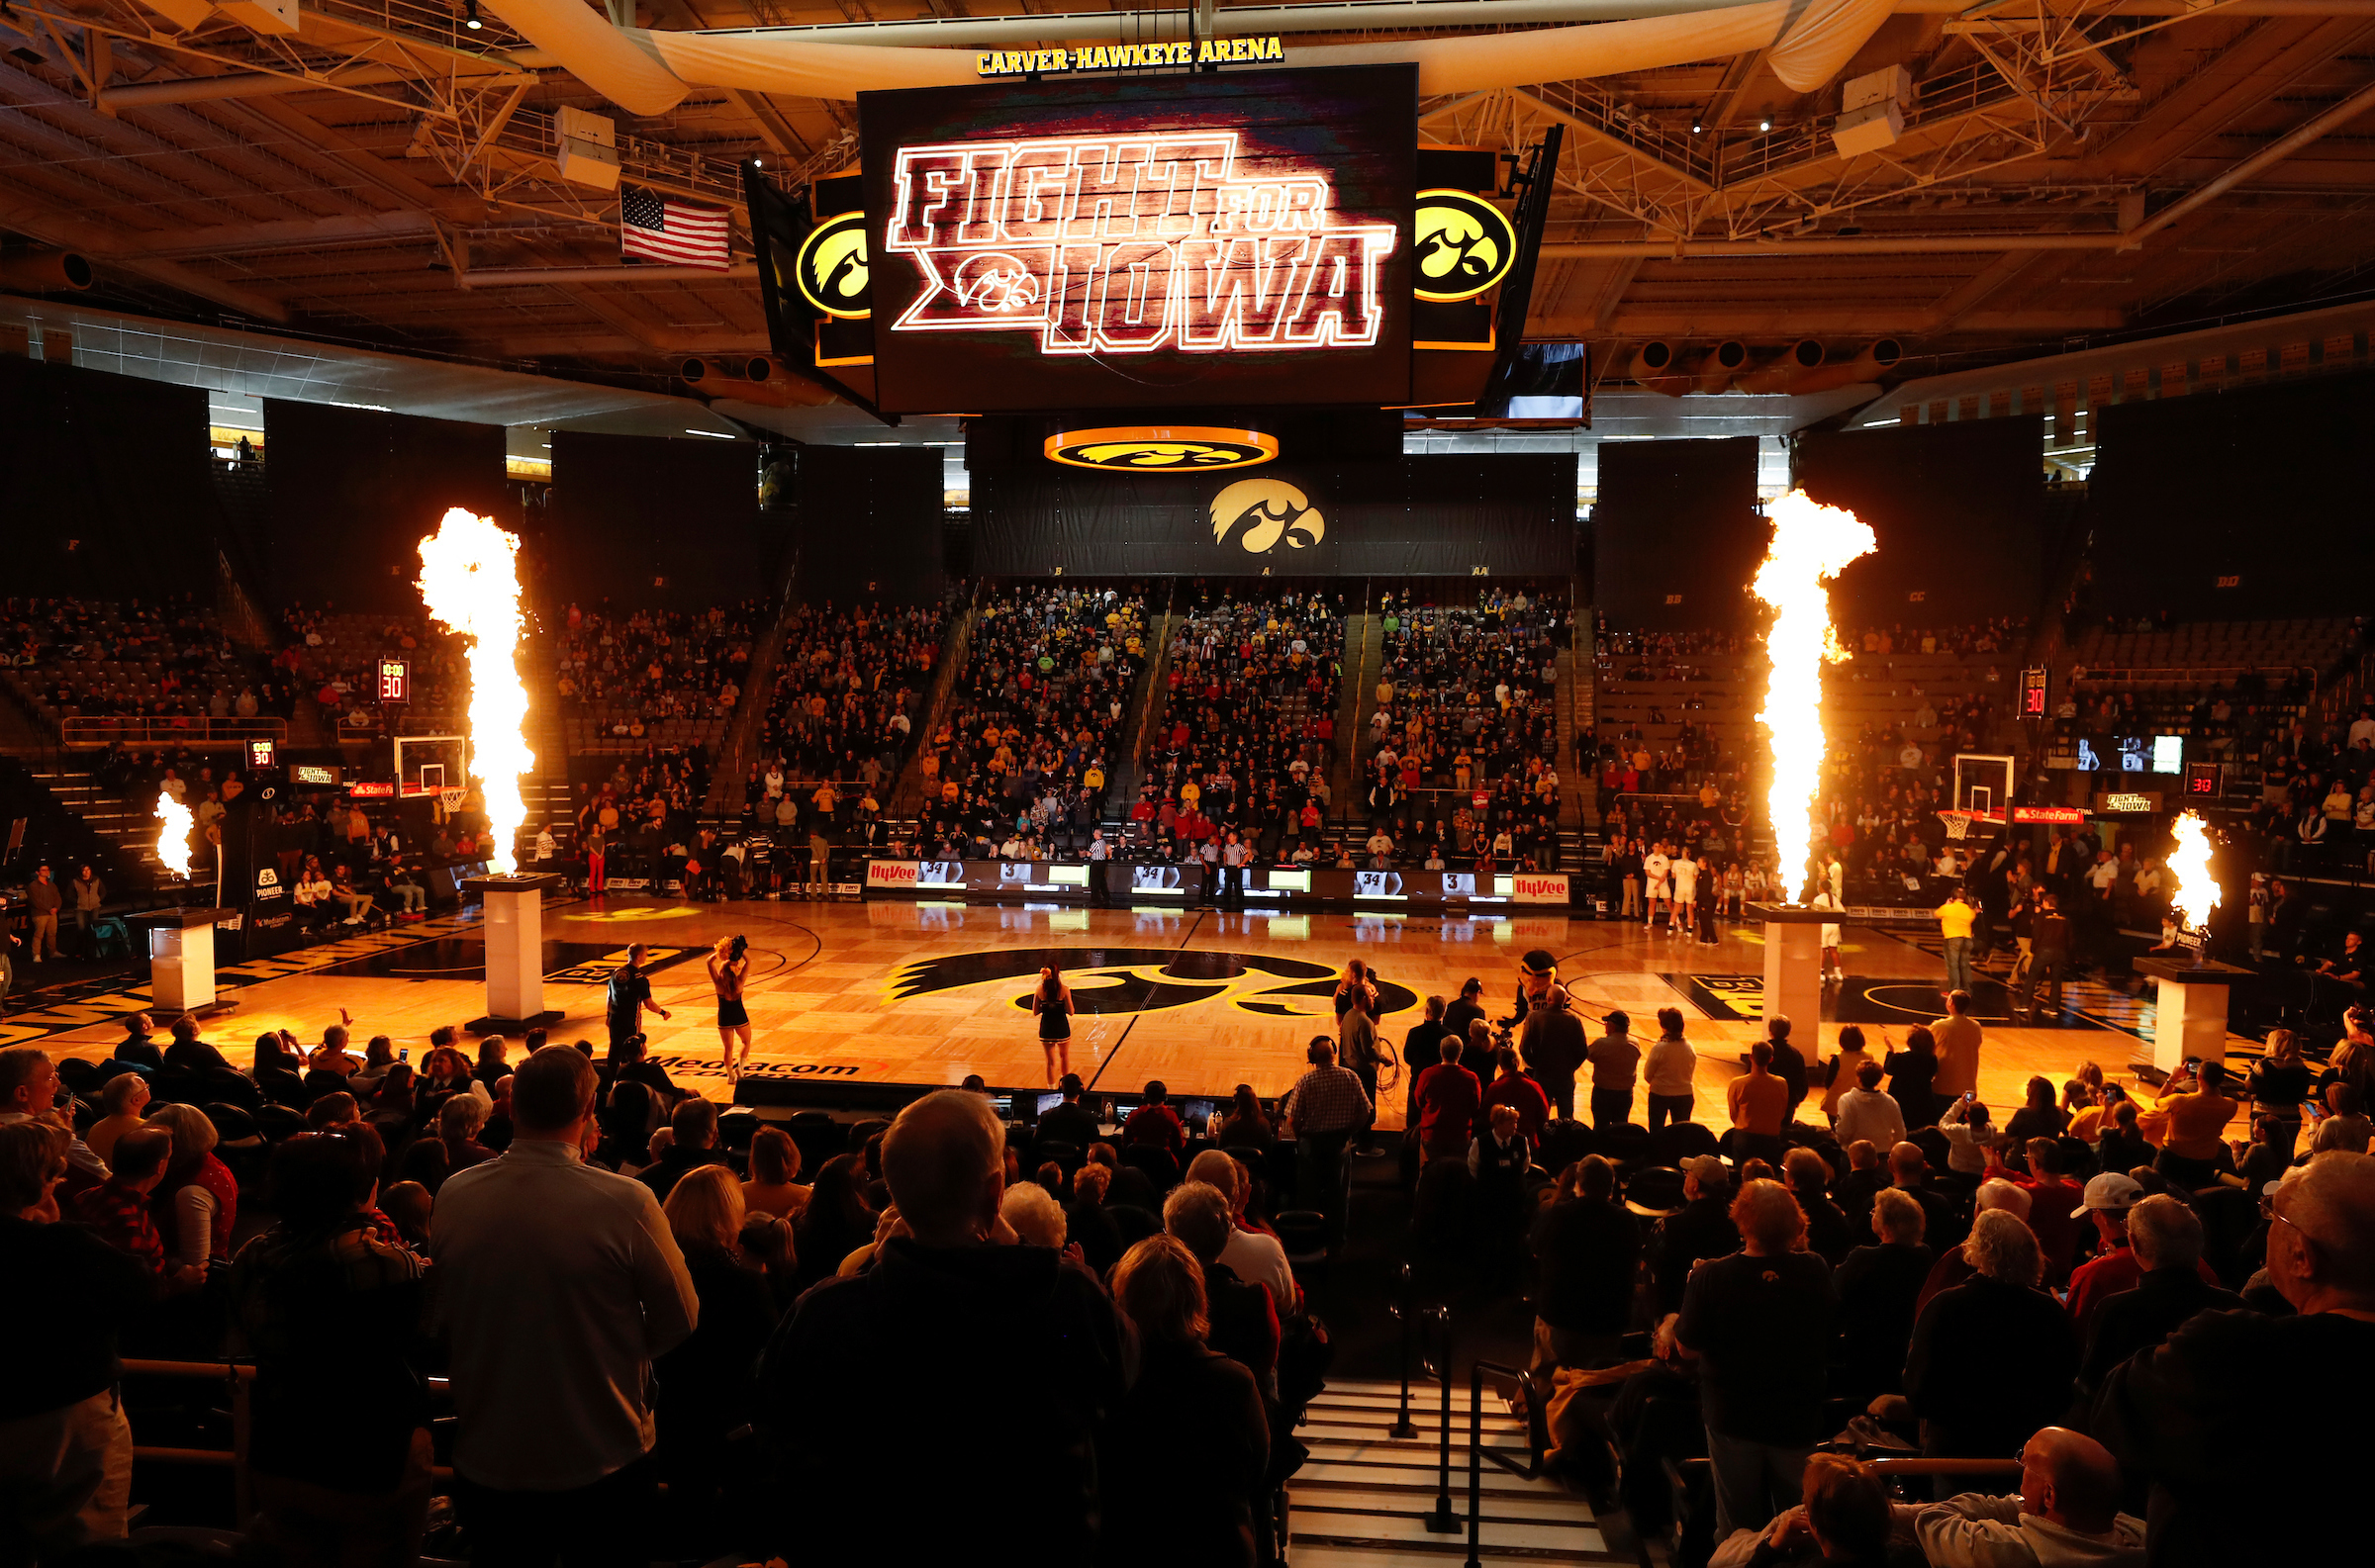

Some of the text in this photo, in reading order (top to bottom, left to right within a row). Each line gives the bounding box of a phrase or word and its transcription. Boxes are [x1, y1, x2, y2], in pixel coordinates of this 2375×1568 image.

[976, 37, 1283, 75] CARVER-HAWKEYE ARENA
[889, 135, 1235, 249] FIGHT
[1209, 179, 1327, 233] FOR
[1043, 227, 1395, 353] IOWA
[383, 664, 404, 677] 10:00
[383, 677, 401, 697] 30
[2027, 689, 2043, 712] 30
[254, 752, 269, 765] 30
[299, 767, 323, 777] FIGHT
[309, 775, 332, 784] IOWA
[2108, 794, 2138, 803] FIGHT
[2121, 801, 2151, 811] IOWA
[927, 862, 942, 874] 34
[1004, 864, 1014, 877] 3
[1142, 868, 1158, 878] 34
[1363, 874, 1380, 886] 34
[1447, 874, 1458, 889] 3
[256, 884, 283, 898] PIONEER
[2177, 932, 2202, 947] PIONEER
